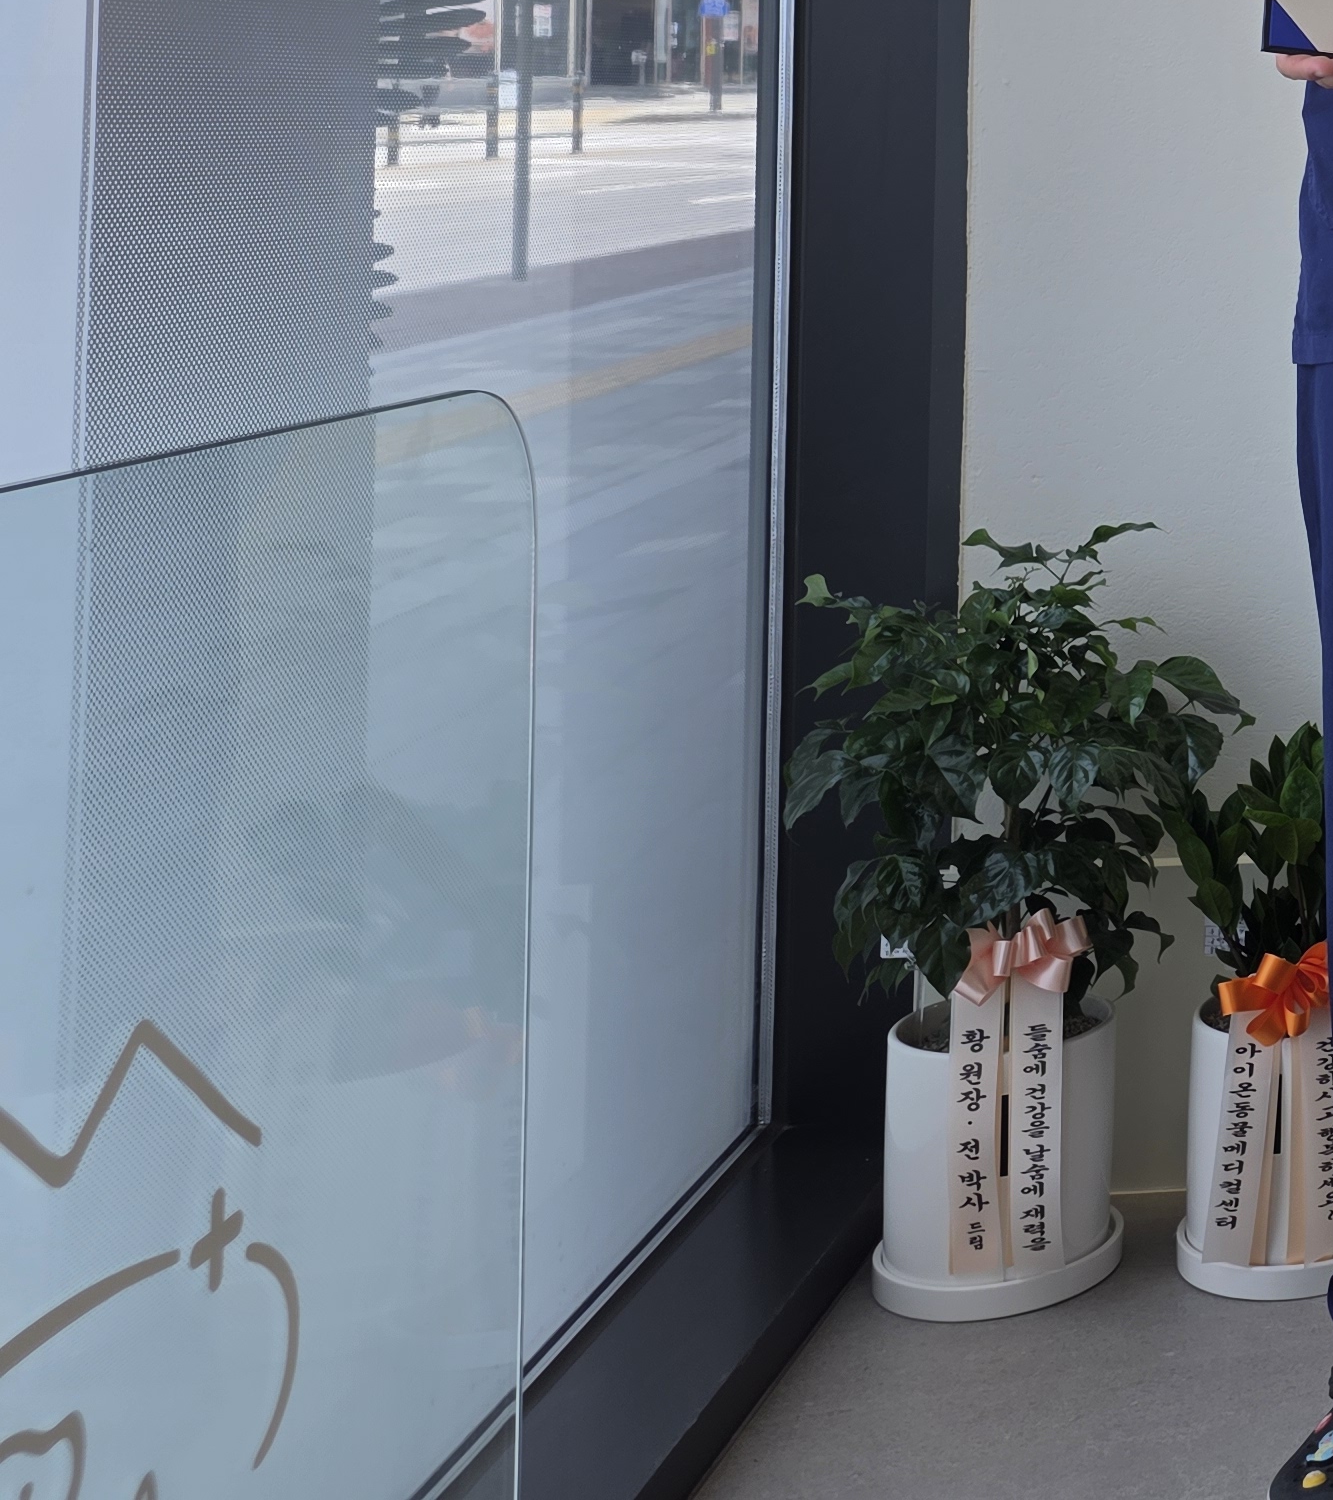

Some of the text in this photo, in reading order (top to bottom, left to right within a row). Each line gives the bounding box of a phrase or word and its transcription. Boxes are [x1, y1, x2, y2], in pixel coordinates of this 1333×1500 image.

[1021, 1084, 1053, 1139] 건강을
[955, 1028, 991, 1252] 황 원장 전 박사 드림
[1020, 1145, 1051, 1200] 날숨에
[1019, 1204, 1052, 1254] 재력을
